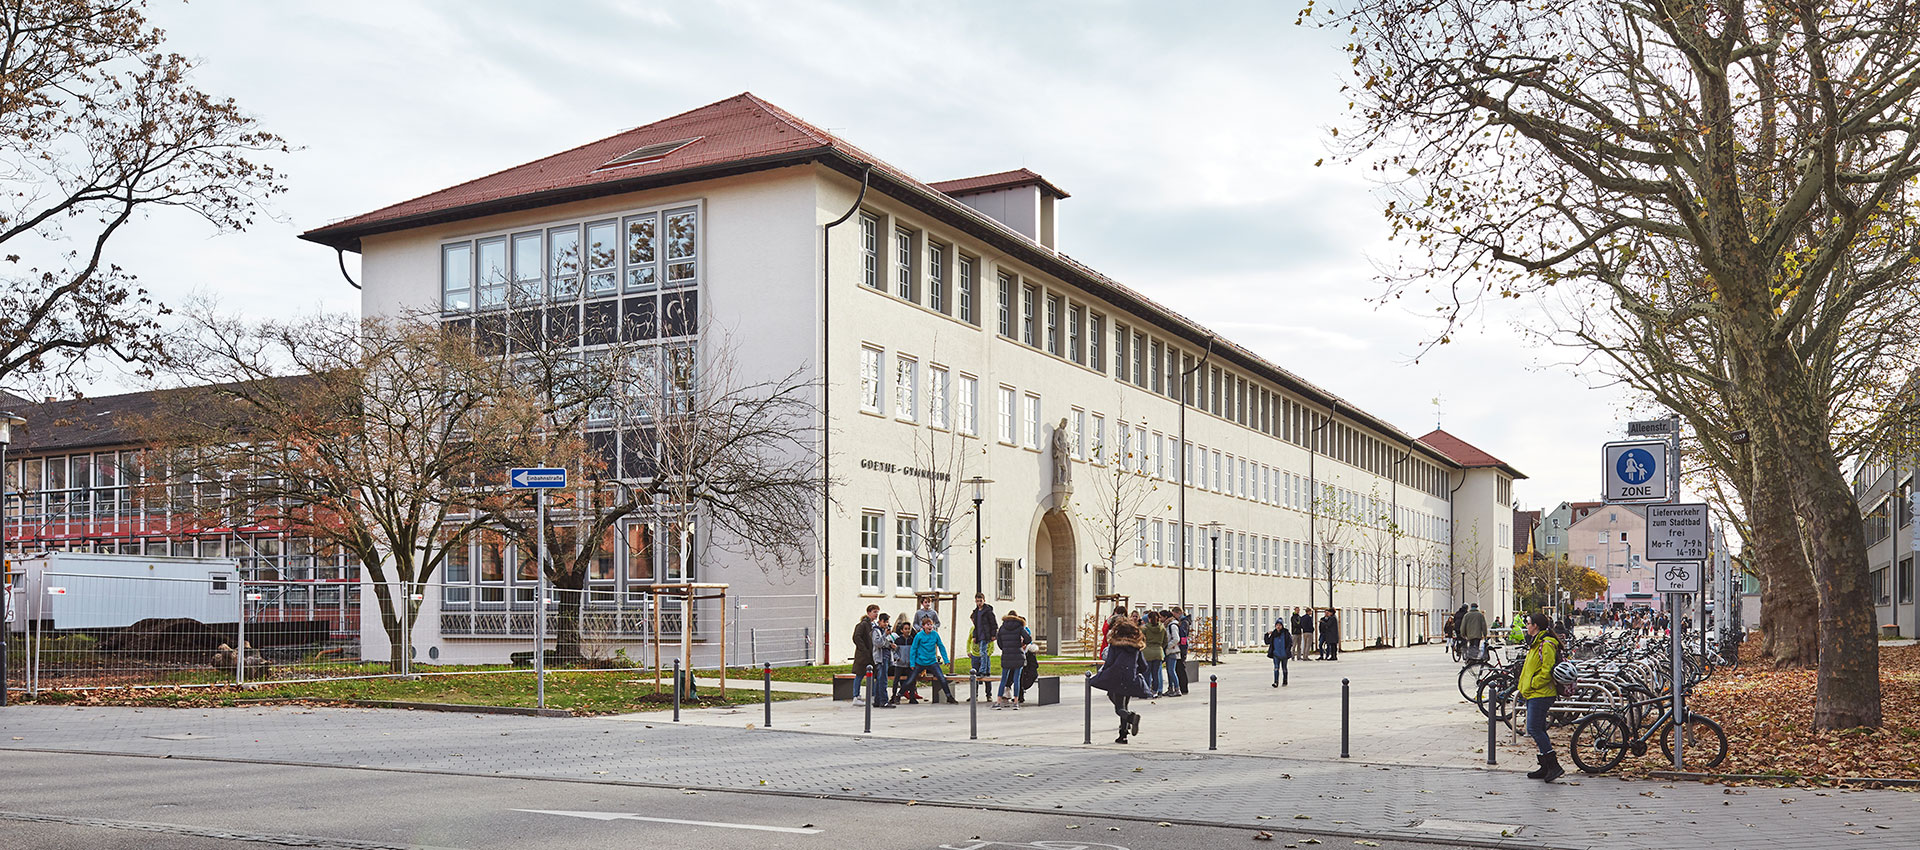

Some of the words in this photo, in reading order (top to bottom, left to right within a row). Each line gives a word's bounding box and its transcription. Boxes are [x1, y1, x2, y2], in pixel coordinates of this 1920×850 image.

[1631, 421, 1668, 433] Alleenstr.
[1621, 486, 1651, 497] ZONE
[1652, 508, 1700, 517] Lieferverkehr
[1652, 519, 1667, 527] zum
[1669, 518, 1701, 526] Stadtbad
[1668, 529, 1685, 537] frei
[1651, 540, 1673, 548] Mo-Fr
[1683, 539, 1696, 547] 7-9
[1697, 539, 1702, 547] h
[1676, 548, 1696, 556] 14-19
[1697, 548, 1702, 556] h
[1670, 581, 1684, 589] frei
